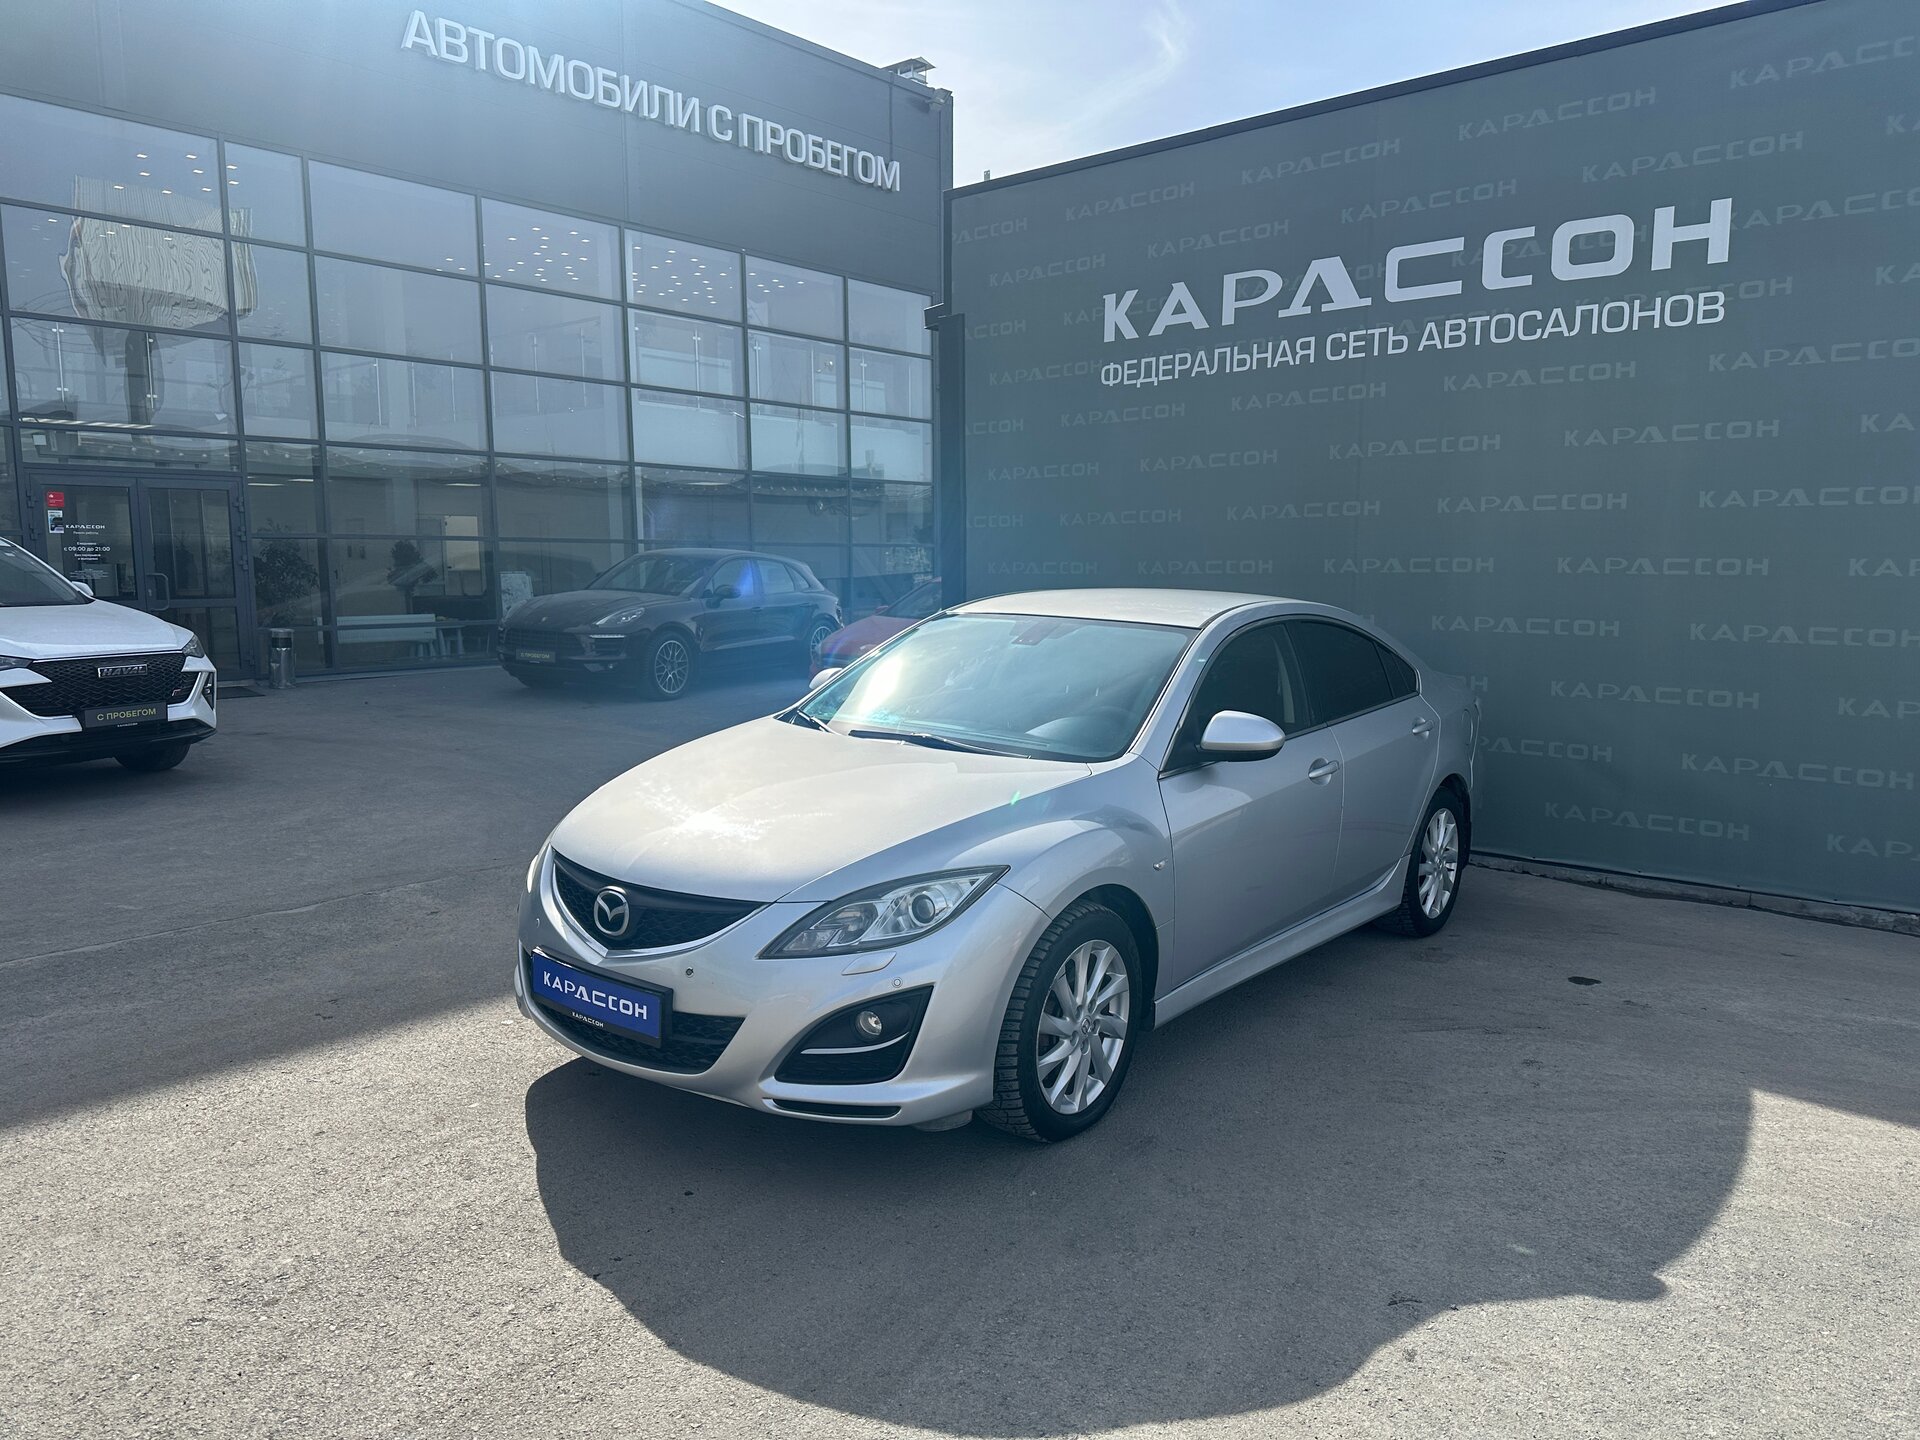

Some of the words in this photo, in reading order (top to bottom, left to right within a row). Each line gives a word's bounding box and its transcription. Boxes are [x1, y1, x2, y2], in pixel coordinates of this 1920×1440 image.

[401, 9, 701, 134] АВТОМОБИЛИ
[706, 104, 733, 142] С
[739, 112, 901, 192] ПРОБЕГОМ
[1100, 336, 1316, 389] ФЕДЕРАЛЬНАЯ
[1325, 325, 1408, 362] СЕТЬ
[1417, 290, 1725, 352] АВТОСАЛОНОВ
[106, 708, 157, 720] ПРОБЕГОМ
